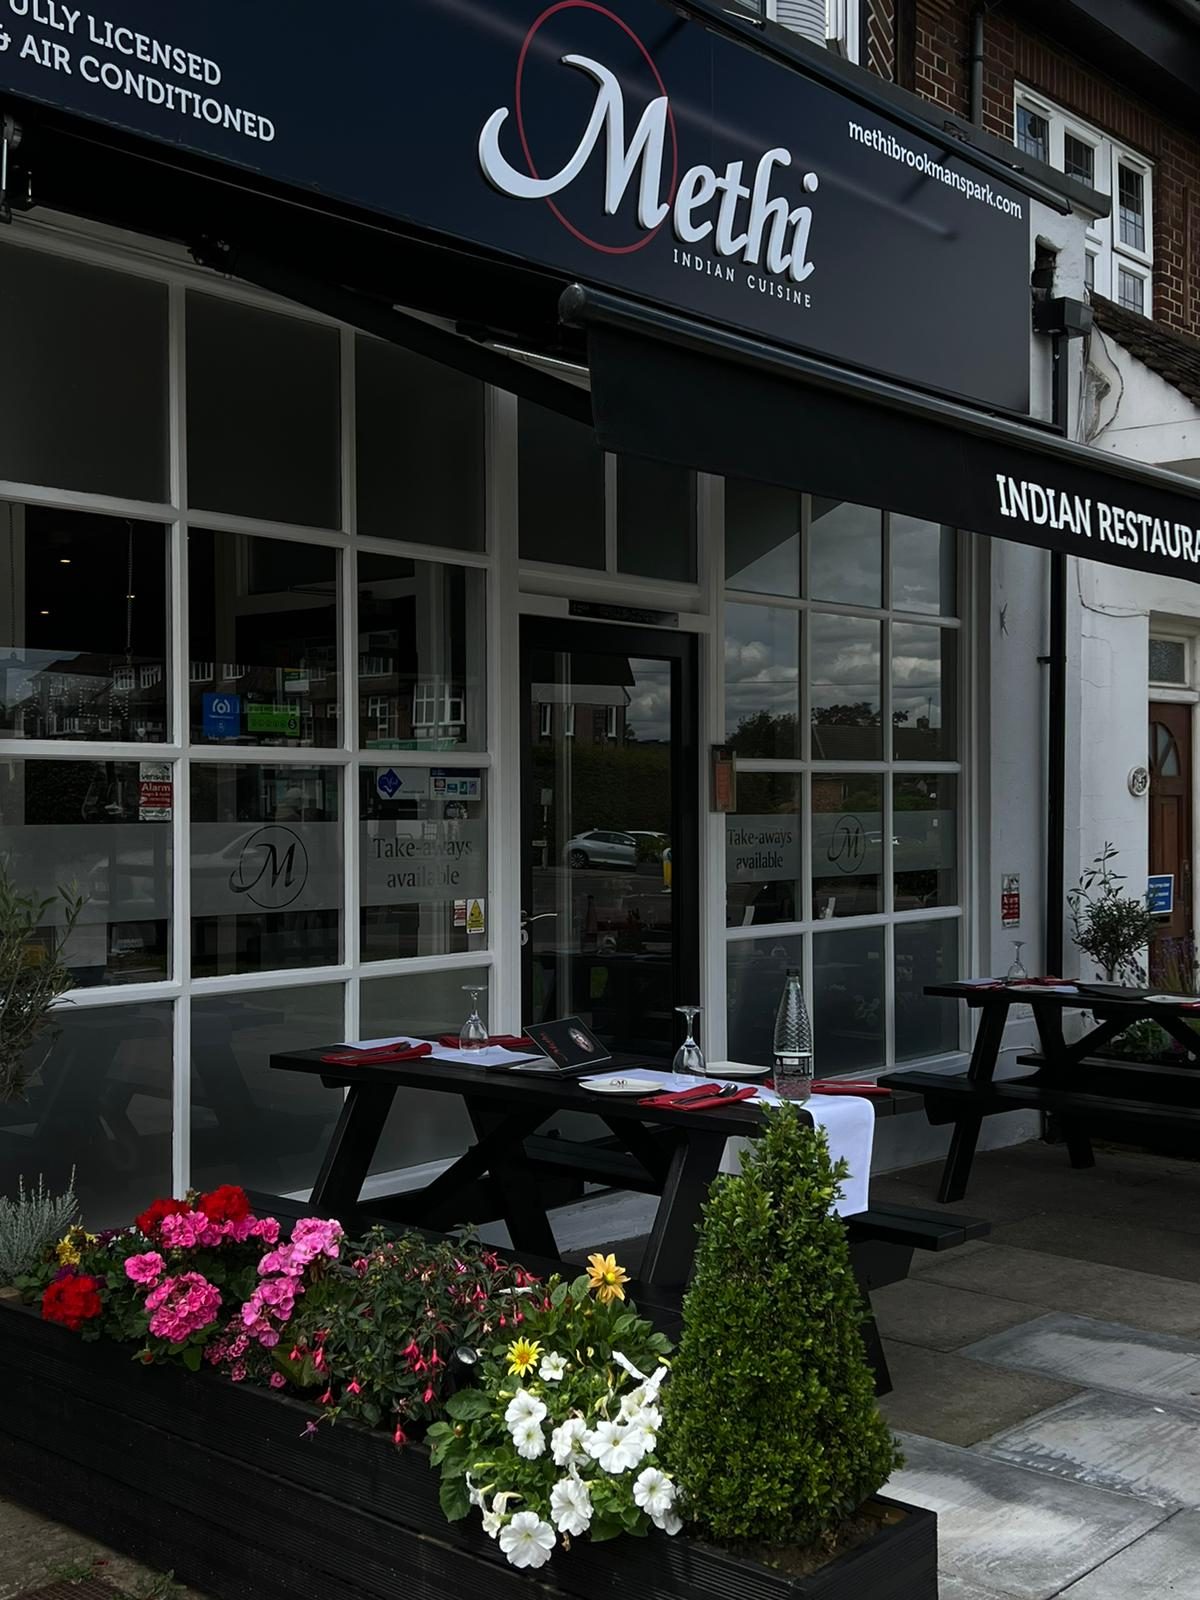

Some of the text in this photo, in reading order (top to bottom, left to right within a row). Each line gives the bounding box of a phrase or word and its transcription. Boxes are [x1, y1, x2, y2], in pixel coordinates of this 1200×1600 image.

[88, 15, 222, 86] LICENSED
[19, 34, 72, 75] AIR
[79, 55, 275, 142] CONDITIONED
[478, 54, 819, 283] Methi
[848, 121, 1023, 220] methibrookmanspark.com
[673, 249, 812, 309] INDIAN CUISINE
[996, 473, 1092, 538] INDIAN
[141, 782, 171, 792] Alarm
[372, 836, 473, 862] Take-aways
[726, 827, 793, 849] Take-aways
[736, 851, 784, 870] available
[386, 863, 461, 889] available
